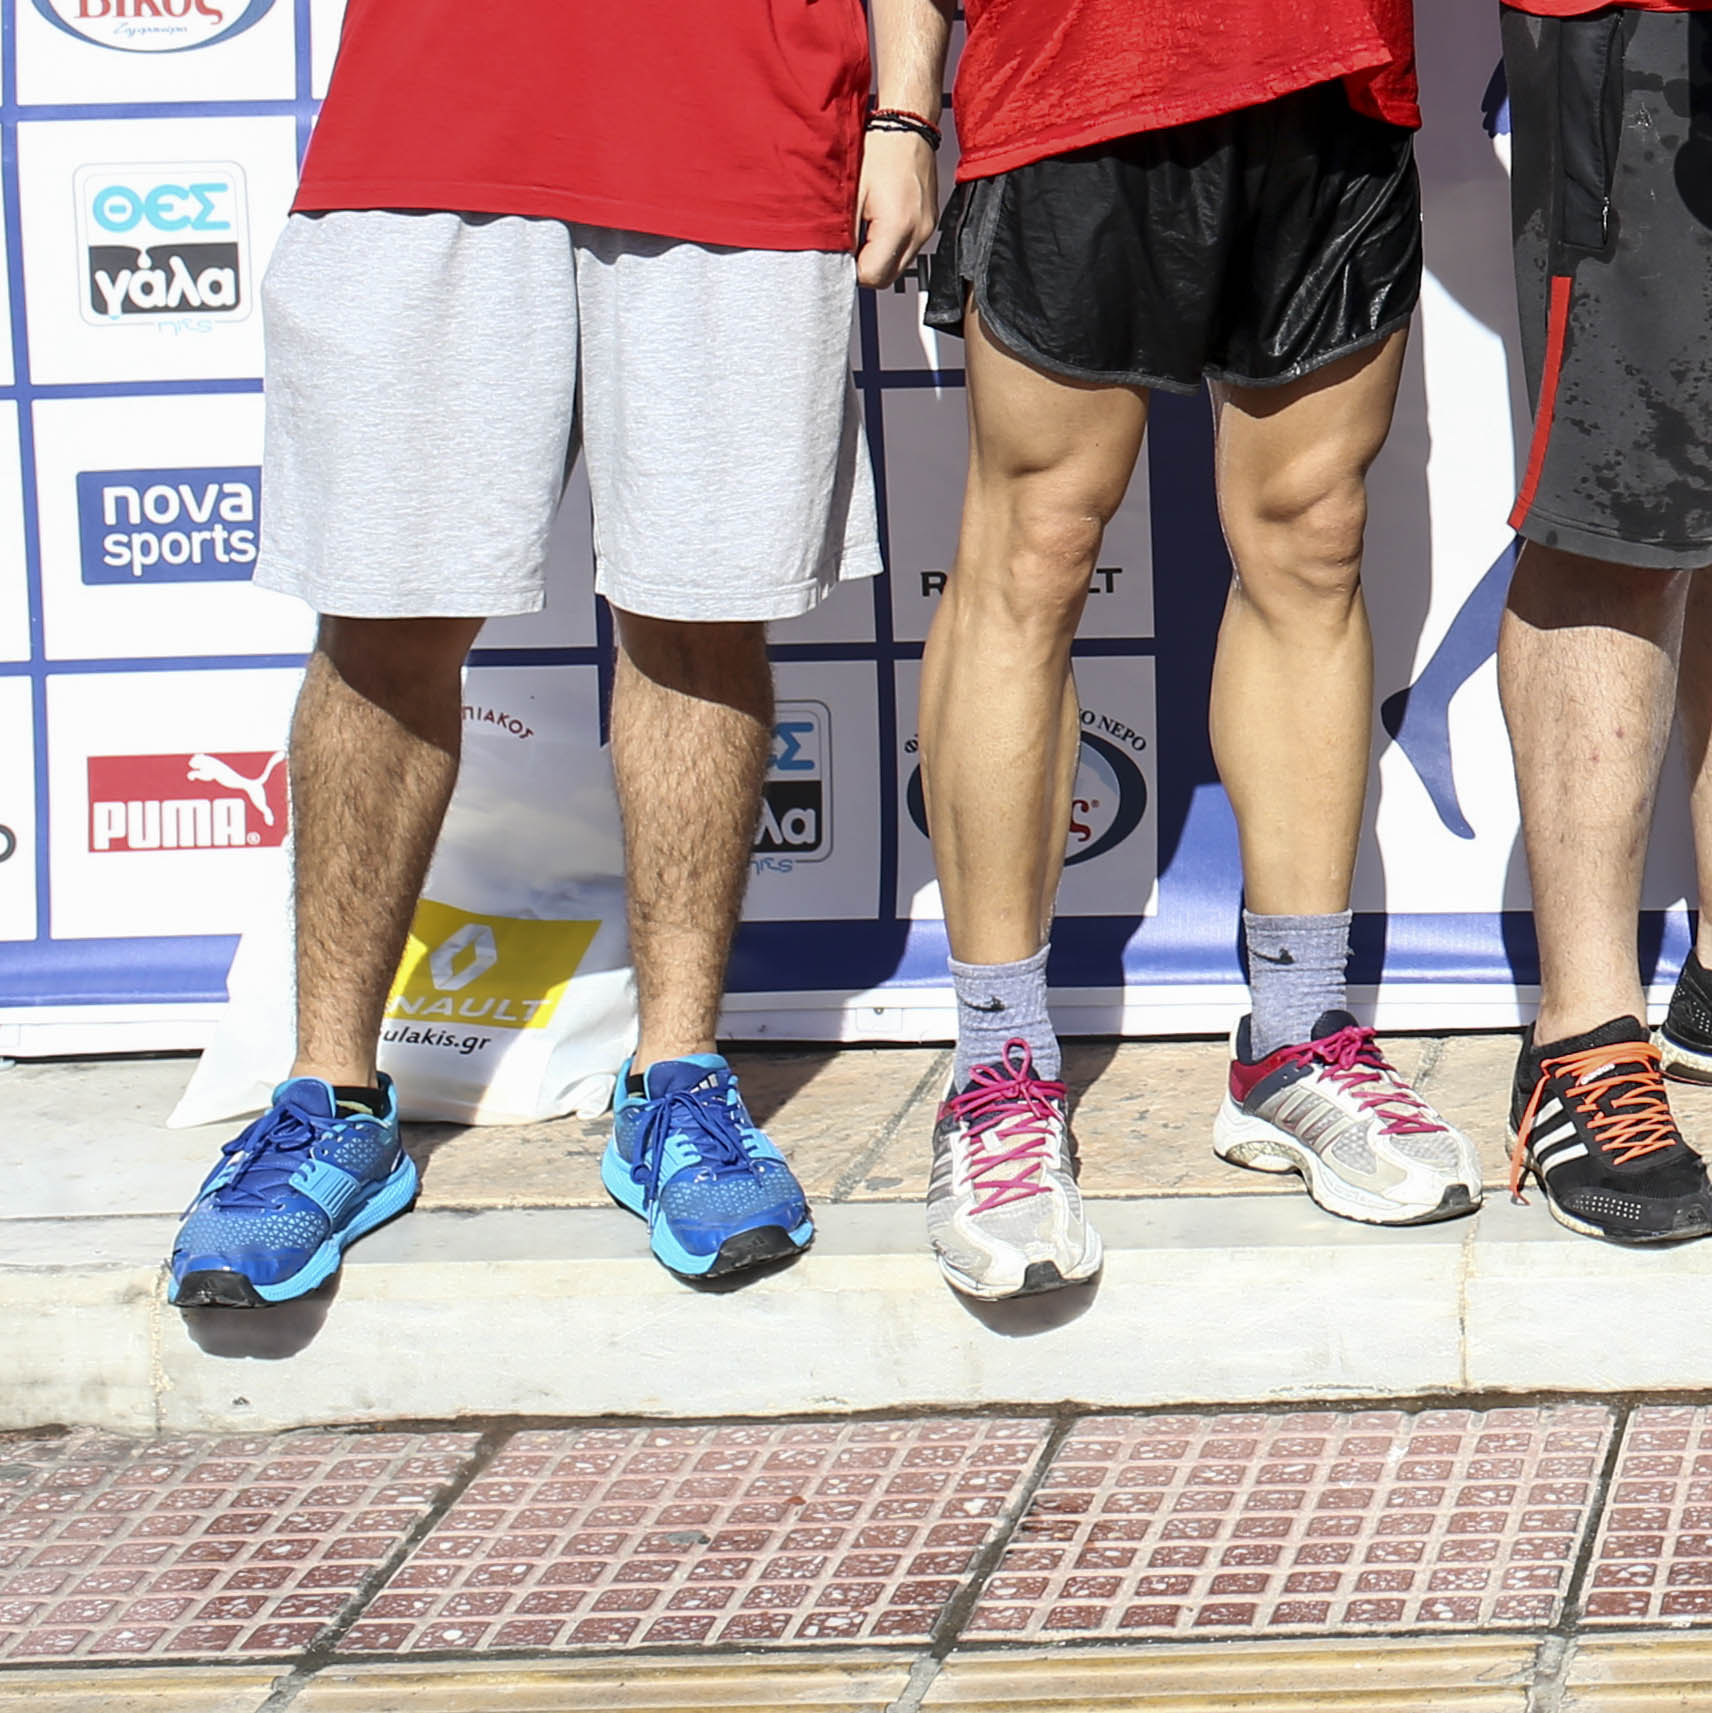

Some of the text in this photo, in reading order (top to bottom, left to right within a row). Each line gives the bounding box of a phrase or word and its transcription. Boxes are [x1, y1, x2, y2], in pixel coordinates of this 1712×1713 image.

[92, 181, 232, 234] ΘΕΣ
[94, 254, 236, 320] γάλα
[102, 482, 254, 526] nova
[102, 527, 257, 577] sports
[1096, 713, 1148, 755] ΝΕΡΟ
[93, 798, 246, 850] PUMA
